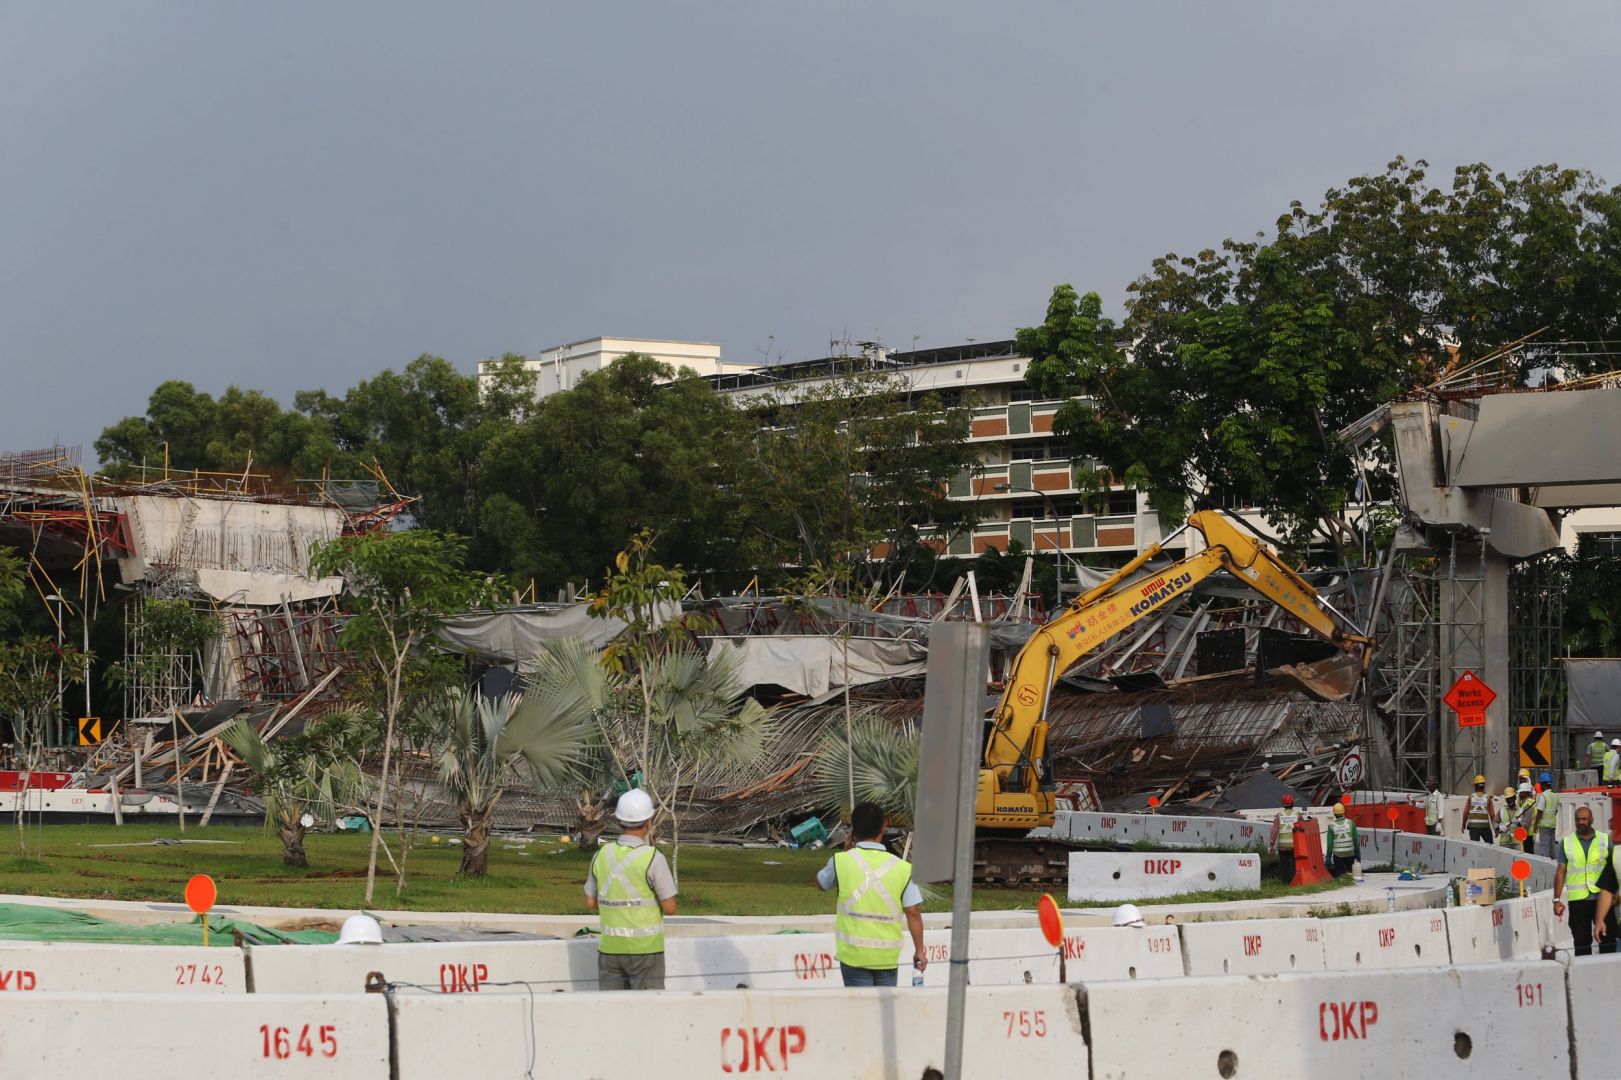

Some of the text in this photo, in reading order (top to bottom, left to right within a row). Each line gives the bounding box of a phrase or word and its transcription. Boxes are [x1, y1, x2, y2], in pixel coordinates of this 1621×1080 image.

[1130, 572, 1192, 616] KOMATSU
[1020, 687, 1038, 704] 51
[1458, 689, 1481, 697] Works
[1457, 700, 1484, 708] Access
[996, 805, 1034, 813] KOMATSU
[1101, 817, 1117, 829] OKP
[1172, 821, 1187, 832] OKP
[1240, 826, 1254, 838] OKP
[1411, 840, 1423, 854] OKP
[1144, 859, 1252, 874] OKP 449
[1491, 908, 1503, 927] OKP
[1148, 938, 1171, 952] 1973
[1243, 936, 1262, 956] OKP
[1379, 928, 1395, 947] OKP
[175, 965, 224, 985] 2742
[794, 953, 833, 980] OKP
[440, 964, 488, 993] OKP
[1516, 983, 1543, 1008] 191
[1003, 1011, 1047, 1039] 755
[1319, 1001, 1378, 1041] OKP
[259, 1024, 338, 1059] 1645
[720, 1025, 806, 1073] OKP
